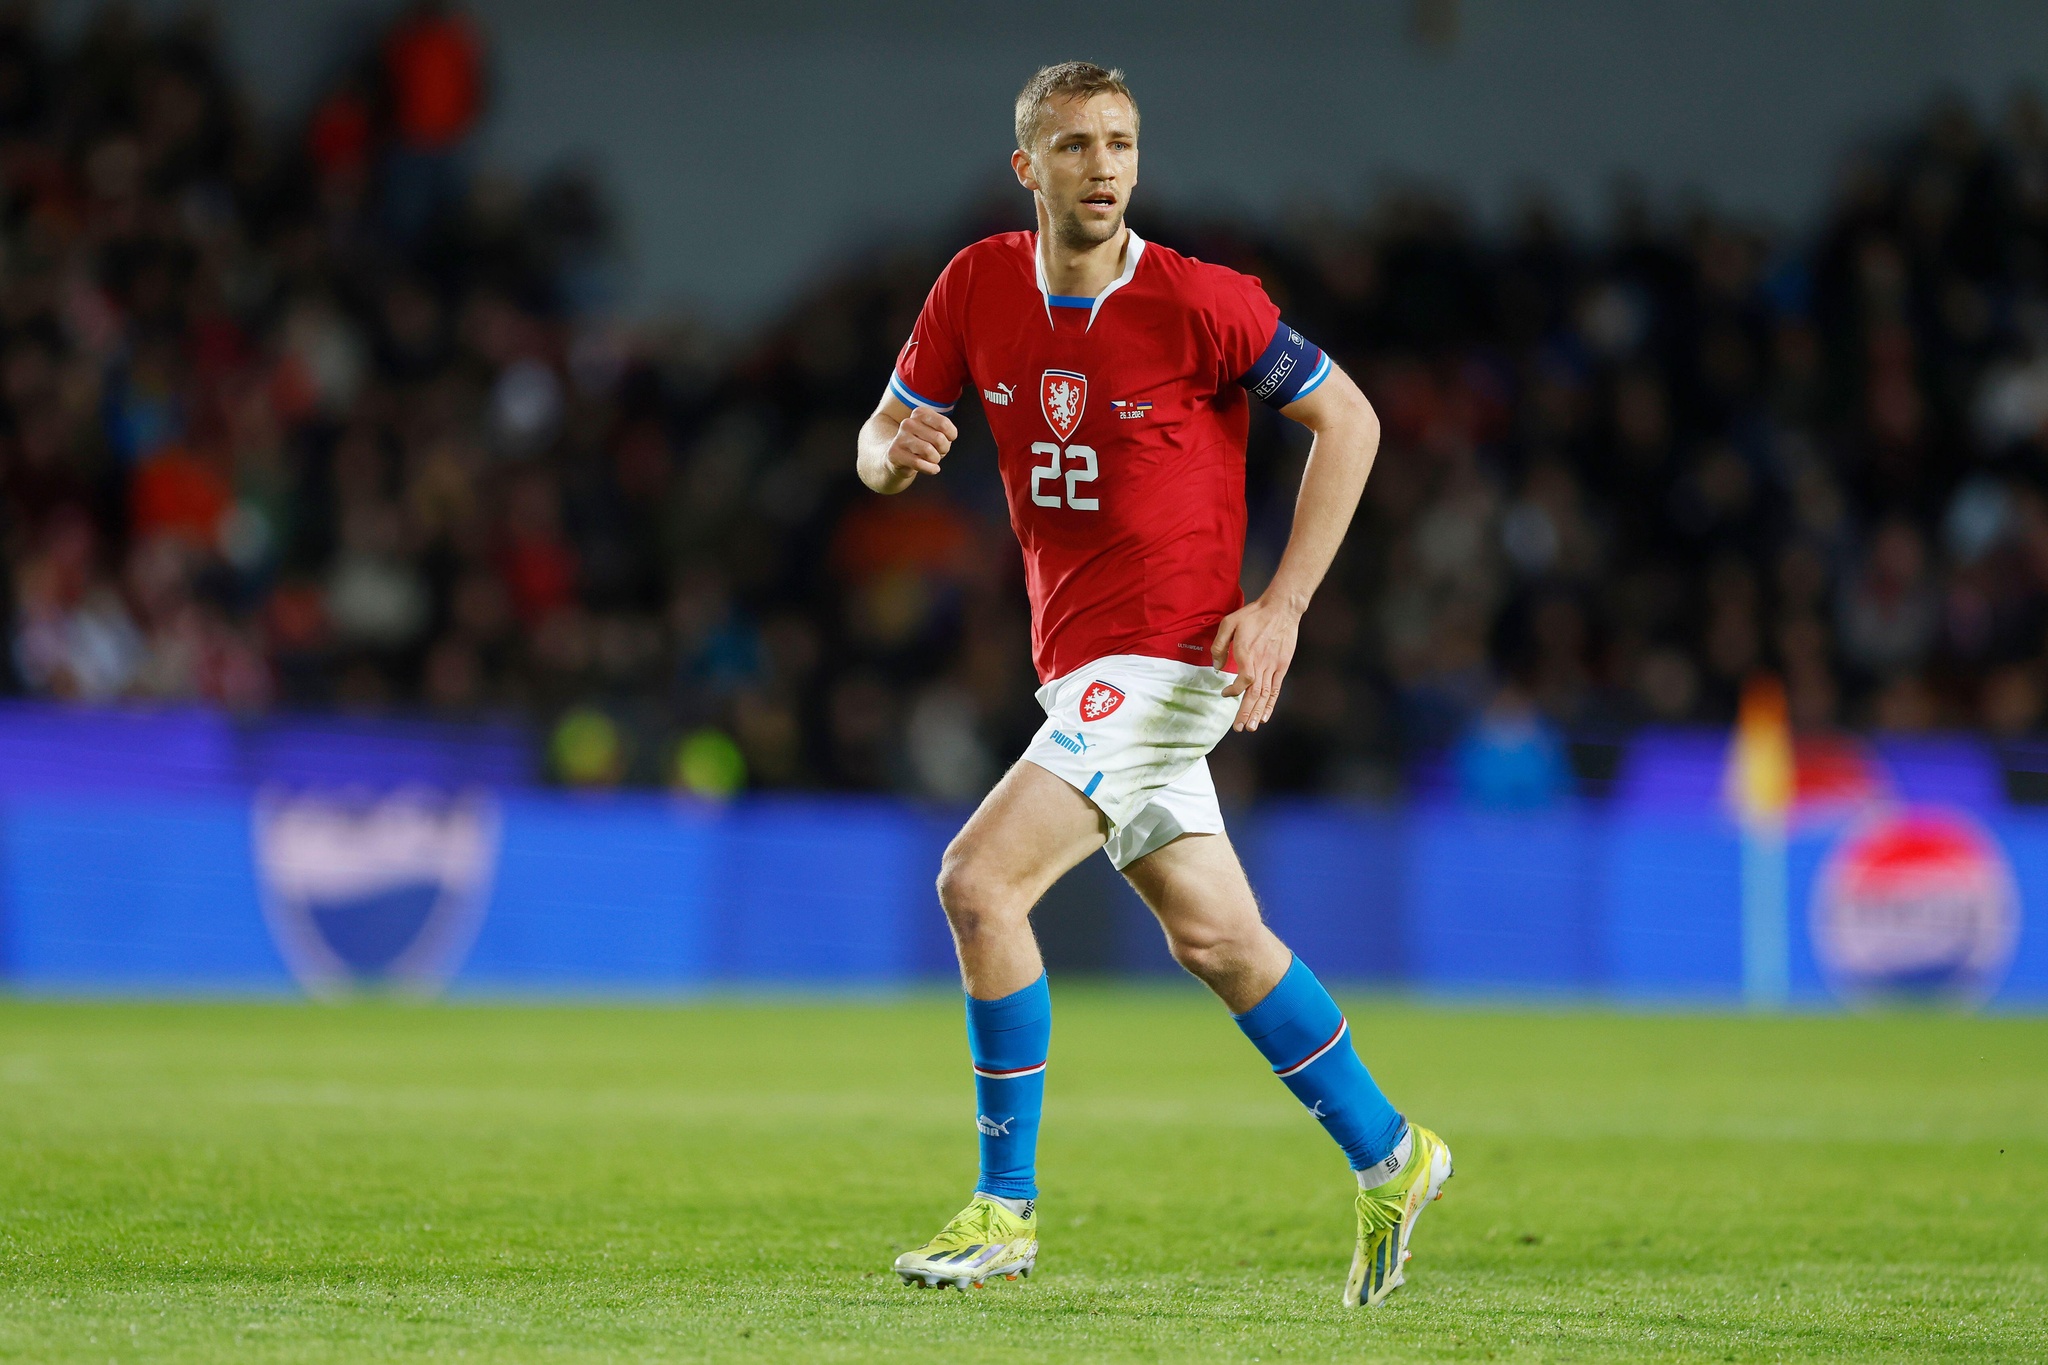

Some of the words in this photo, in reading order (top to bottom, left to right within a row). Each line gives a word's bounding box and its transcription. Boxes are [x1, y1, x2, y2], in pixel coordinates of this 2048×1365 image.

[1256, 353, 1293, 397] RESPECT
[984, 389, 1008, 406] PUMA
[1031, 441, 1099, 511] 22
[1050, 729, 1081, 755] PUMA
[1384, 1151, 1401, 1174] IGN
